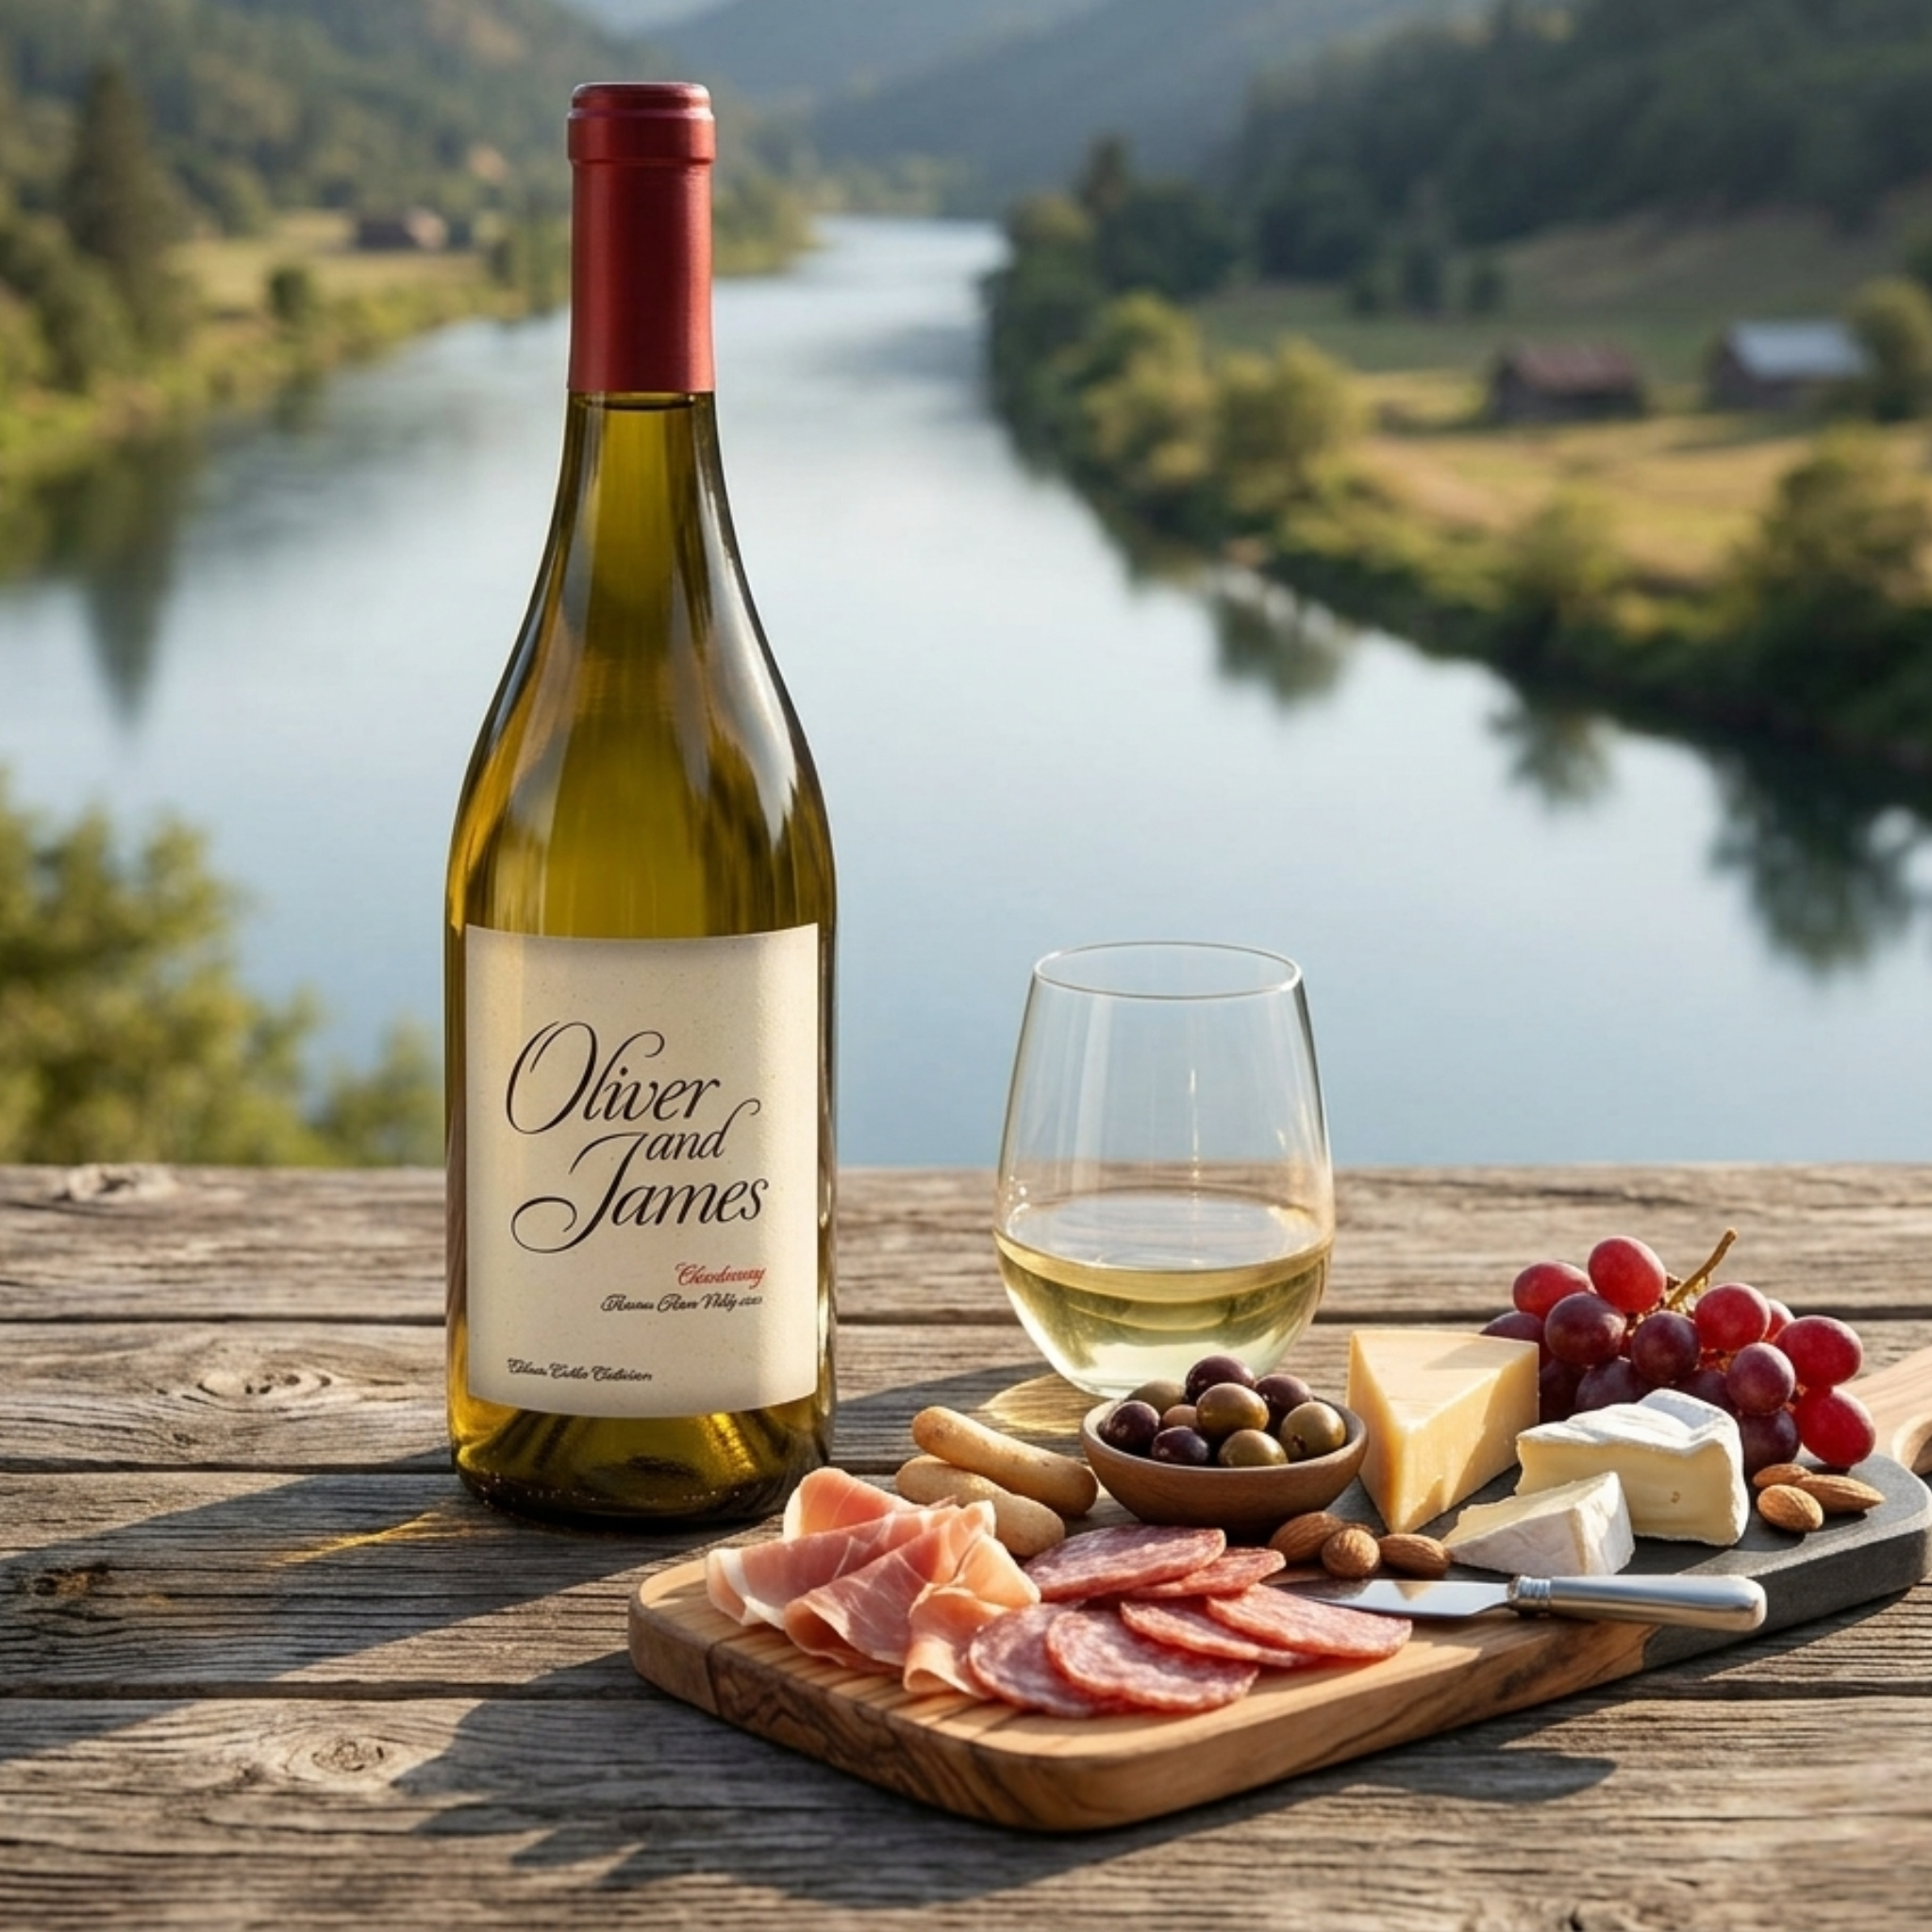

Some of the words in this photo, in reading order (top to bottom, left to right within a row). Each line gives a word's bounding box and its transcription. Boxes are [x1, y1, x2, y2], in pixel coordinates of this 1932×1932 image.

[507, 1021, 721, 1135] Oliver
[645, 1098, 761, 1161] and
[510, 1131, 770, 1254] James
